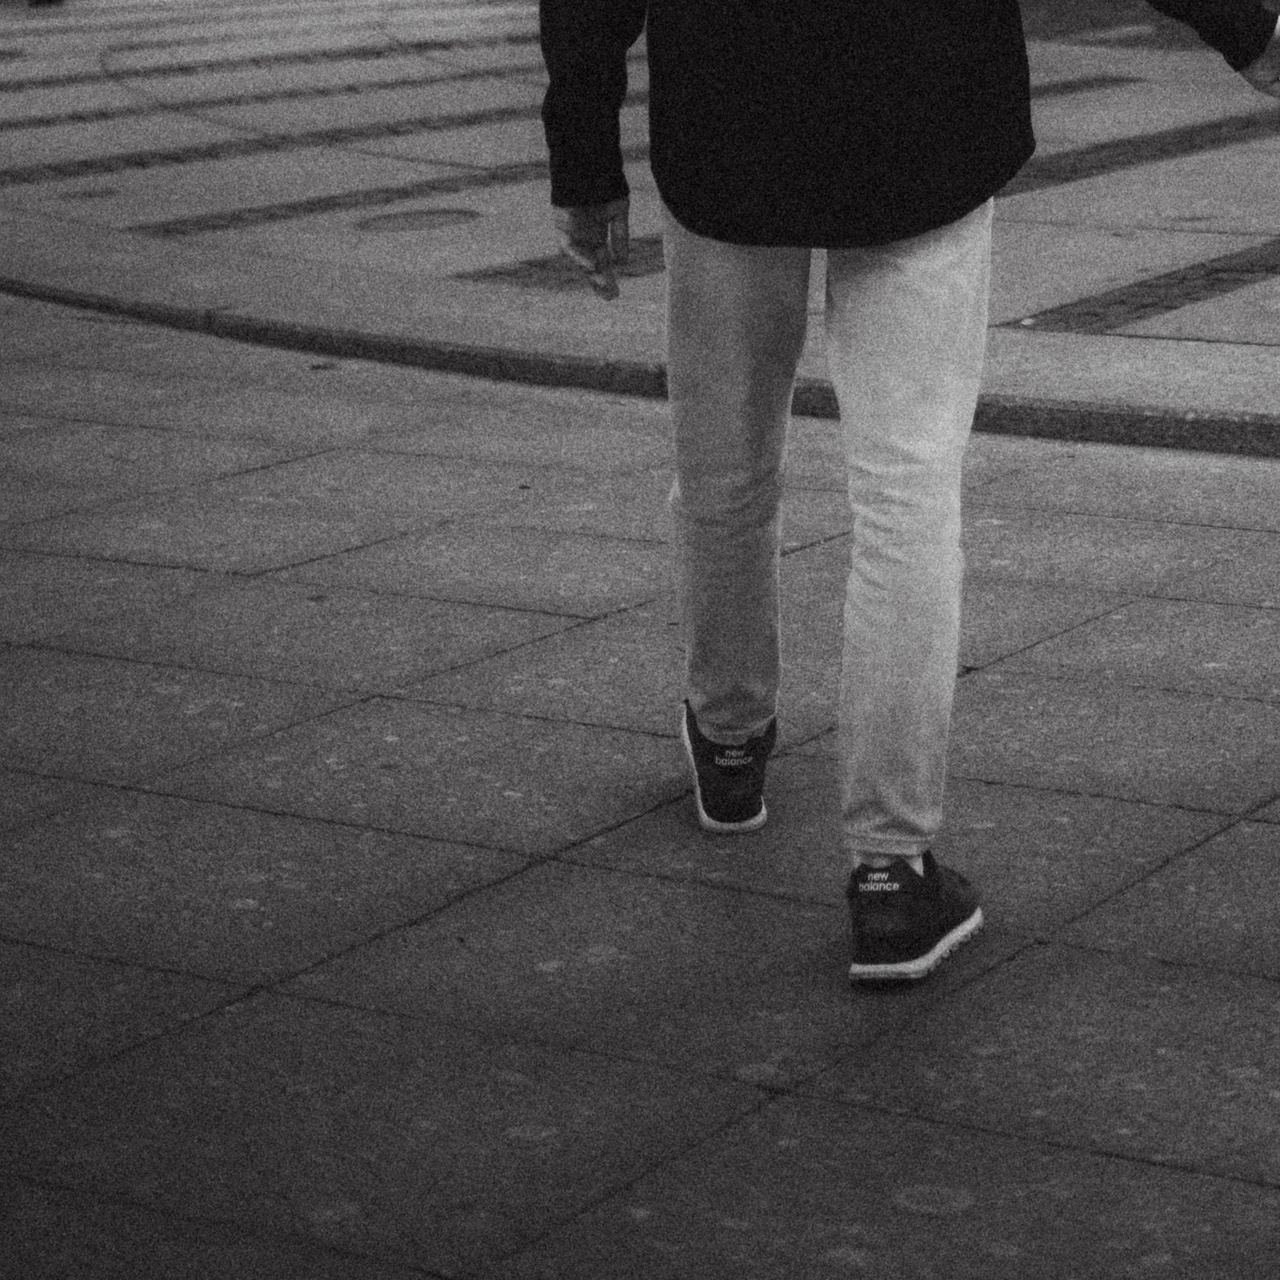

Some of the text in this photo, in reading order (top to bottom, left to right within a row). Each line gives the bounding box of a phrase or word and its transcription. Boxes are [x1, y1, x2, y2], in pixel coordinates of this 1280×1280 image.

[725, 750, 745, 758] new
[867, 872, 889, 881] new
[858, 880, 900, 892] balance
